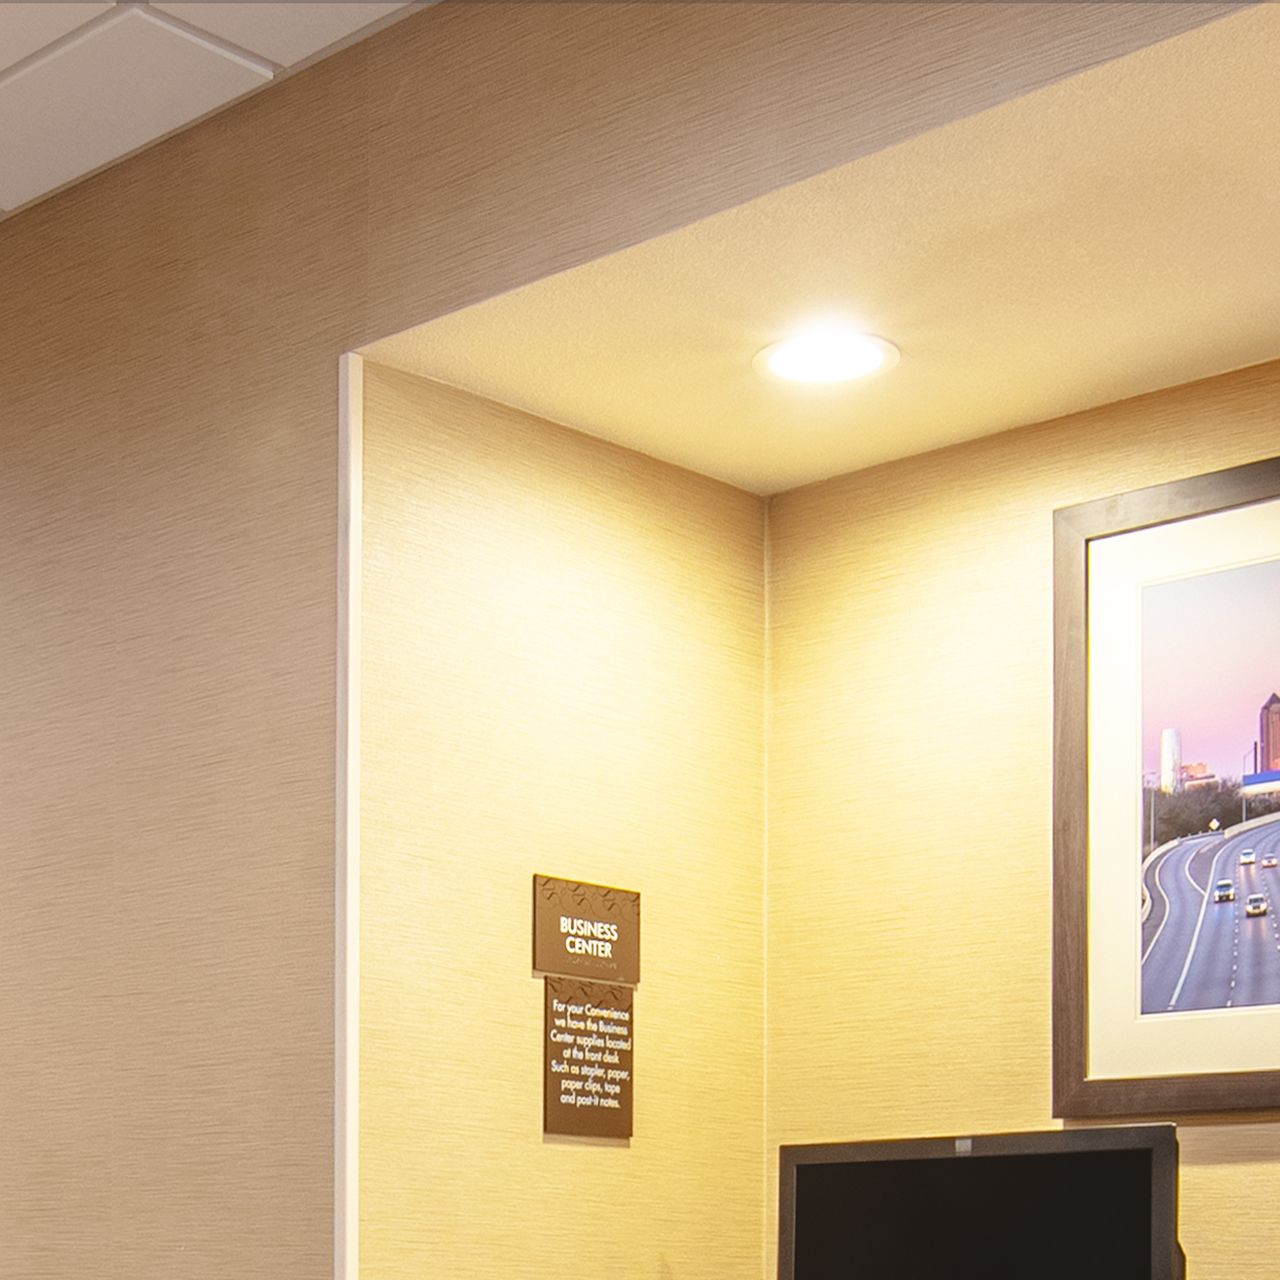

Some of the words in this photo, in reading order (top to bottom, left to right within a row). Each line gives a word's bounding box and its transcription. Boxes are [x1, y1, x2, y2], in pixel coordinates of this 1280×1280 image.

[560, 916, 618, 941] BUSINESS
[565, 936, 612, 958] CENTER
[552, 999, 566, 1012] For
[567, 1004, 583, 1017] your
[584, 1003, 630, 1020] Convenience
[554, 1018, 566, 1028] we
[567, 1016, 585, 1030] have
[586, 1017, 598, 1031] the
[599, 1020, 628, 1036] Business
[550, 1029, 575, 1044] Center
[576, 1033, 605, 1051] supplies
[605, 1034, 631, 1051] located
[562, 1047, 571, 1059] at
[572, 1045, 584, 1060] the
[585, 1047, 602, 1062] front
[551, 1059, 569, 1073] Such
[570, 1065, 580, 1075] as
[581, 1063, 606, 1079] stapler,
[607, 1069, 630, 1082] paper,
[561, 1079, 583, 1092] paper
[584, 1077, 603, 1094] clips,
[604, 1081, 621, 1096] tape
[560, 1091, 576, 1104] and
